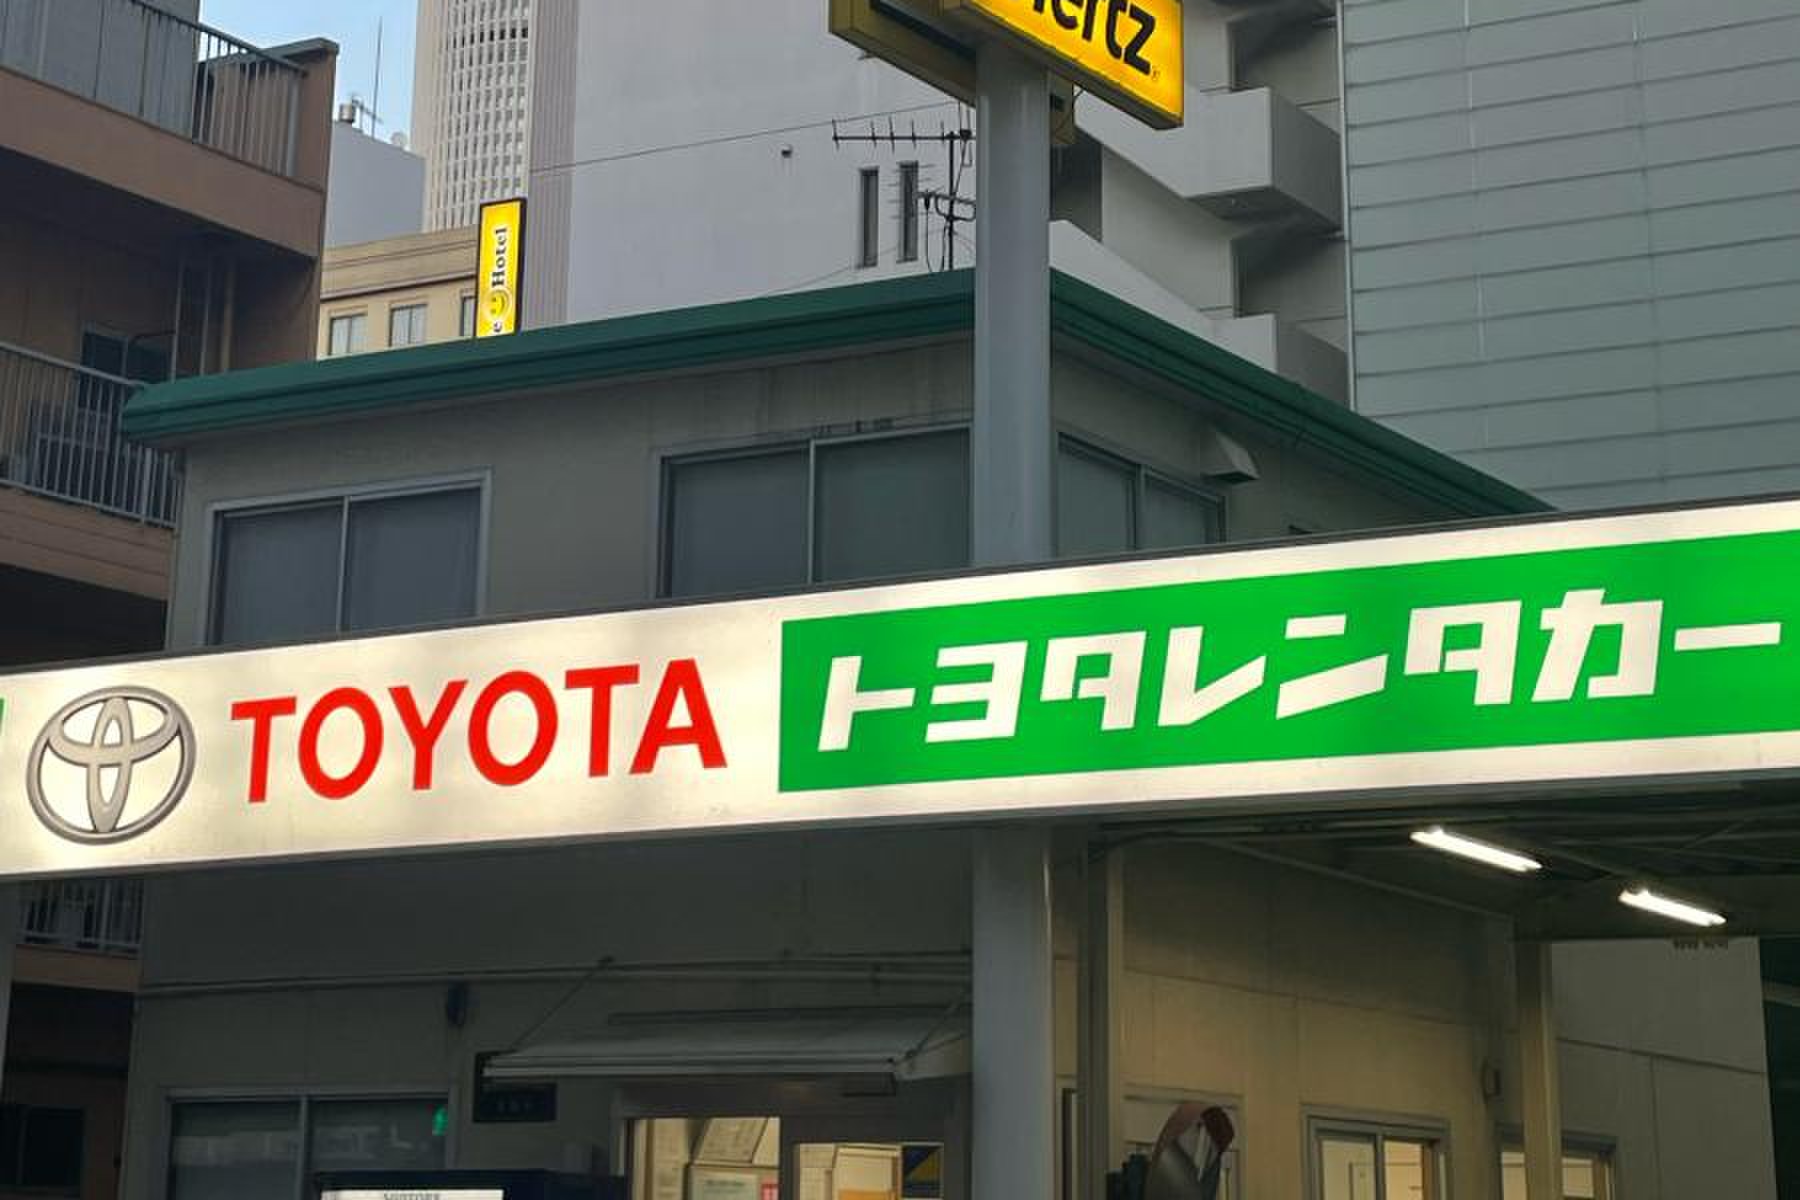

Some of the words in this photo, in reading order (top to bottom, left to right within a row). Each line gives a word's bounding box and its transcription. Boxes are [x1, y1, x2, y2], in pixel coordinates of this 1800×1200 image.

[492, 228, 508, 288] Hotel
[231, 657, 728, 803] TOYOTA
[817, 586, 1782, 752] トヨタレンタカー
